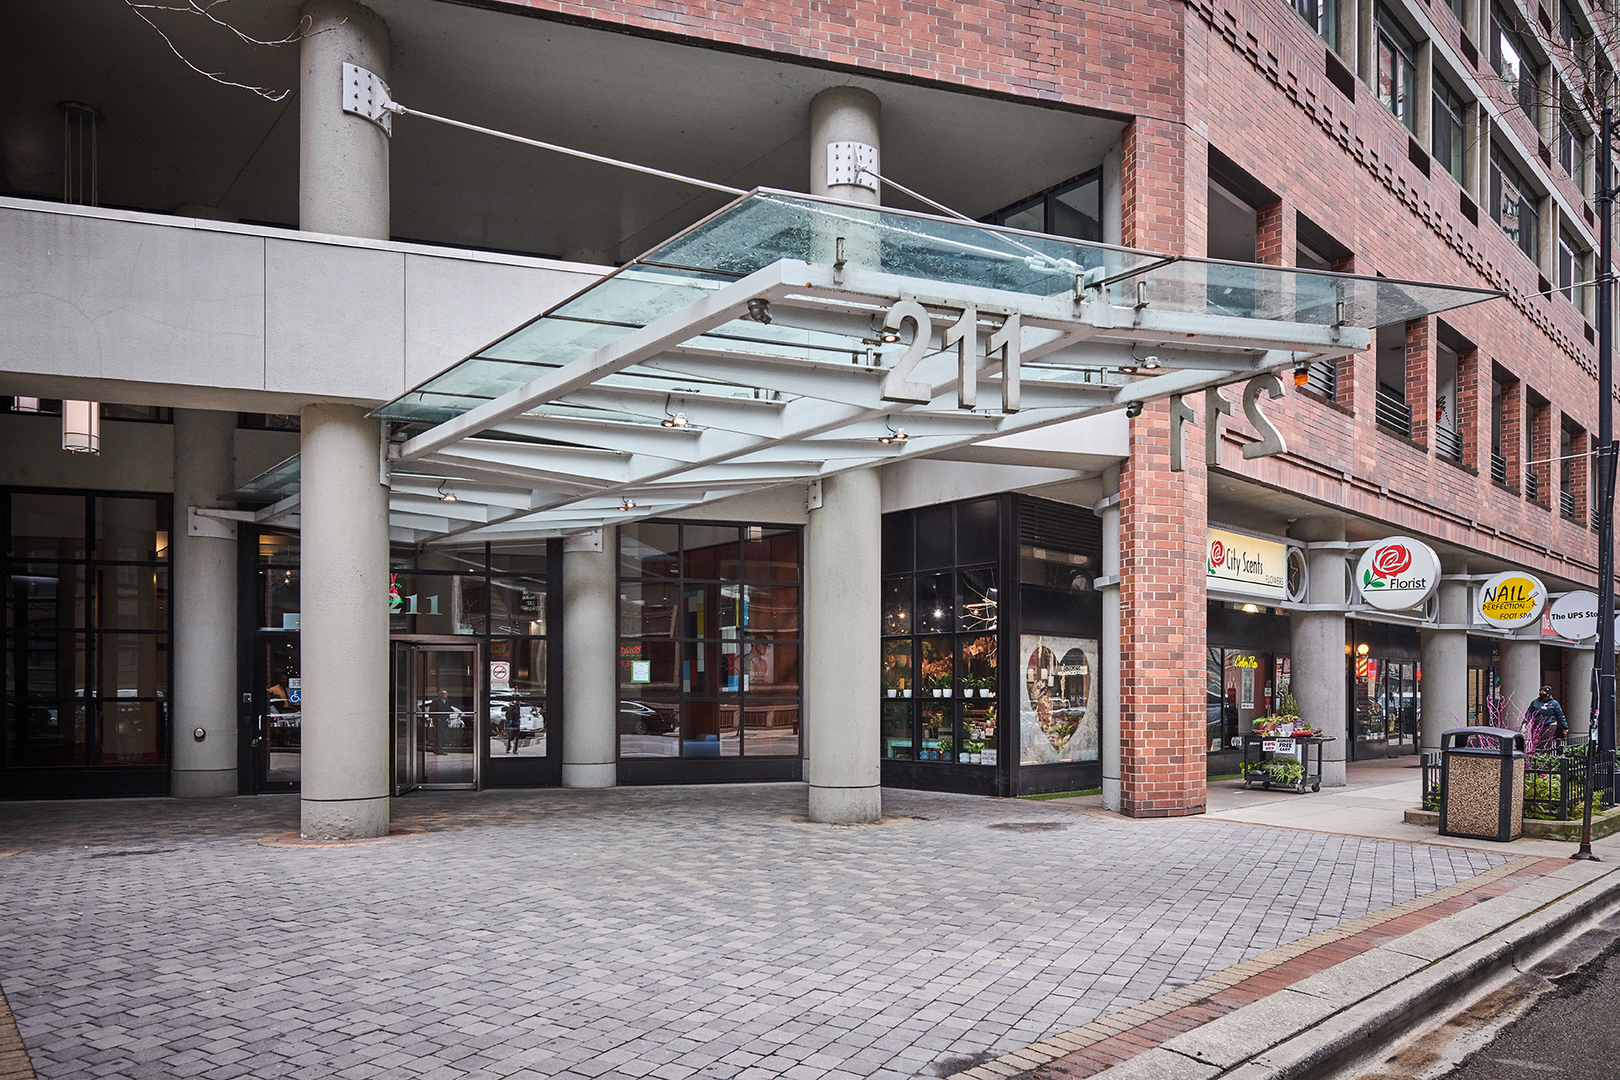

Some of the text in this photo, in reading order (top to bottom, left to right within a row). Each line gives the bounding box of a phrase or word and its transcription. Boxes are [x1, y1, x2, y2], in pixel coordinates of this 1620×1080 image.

[880, 300, 1021, 414] 211
[1226, 548, 1263, 576] City Scents
[1265, 574, 1284, 586] FLOWERS
[1390, 578, 1426, 589] Florist
[1483, 585, 1526, 603] NAIL
[1567, 611, 1583, 619] UPS
